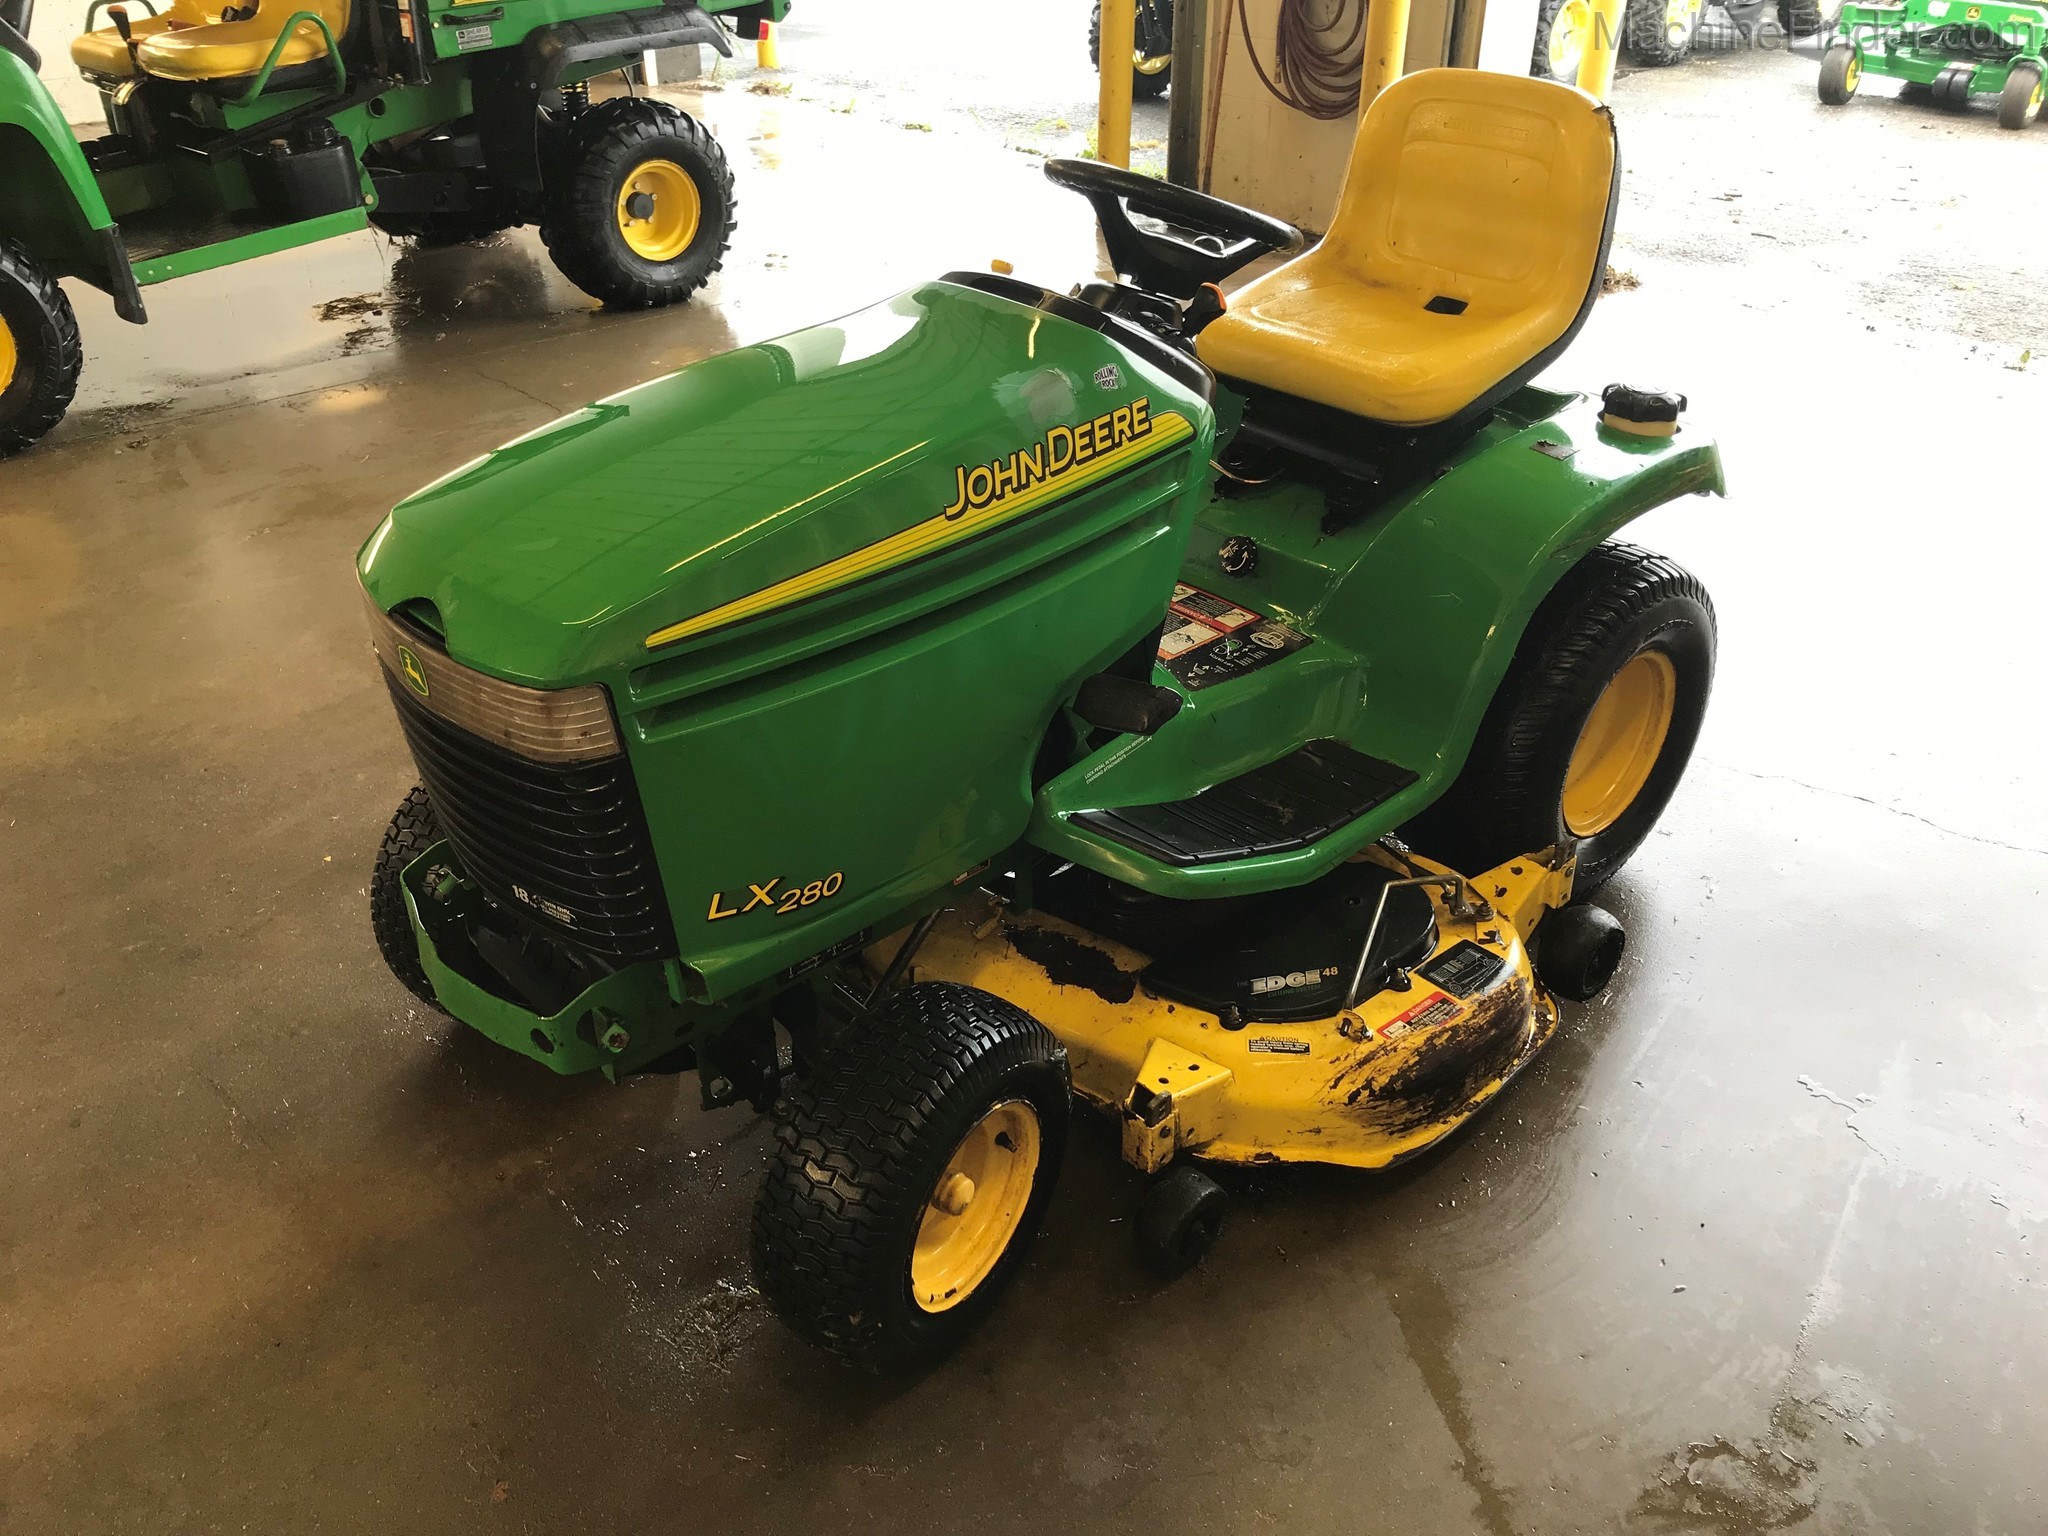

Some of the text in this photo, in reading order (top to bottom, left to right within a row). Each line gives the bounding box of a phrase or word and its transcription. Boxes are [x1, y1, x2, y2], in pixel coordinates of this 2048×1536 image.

[1094, 366, 1118, 382] ROLLING
[1101, 378, 1116, 388] ROCK
[945, 396, 1152, 519] JOHN DEERE
[512, 885, 529, 903] 18
[1250, 969, 1321, 994] EDGE
[1322, 966, 1339, 977] 48
[1414, 998, 1434, 1013] DANGER
